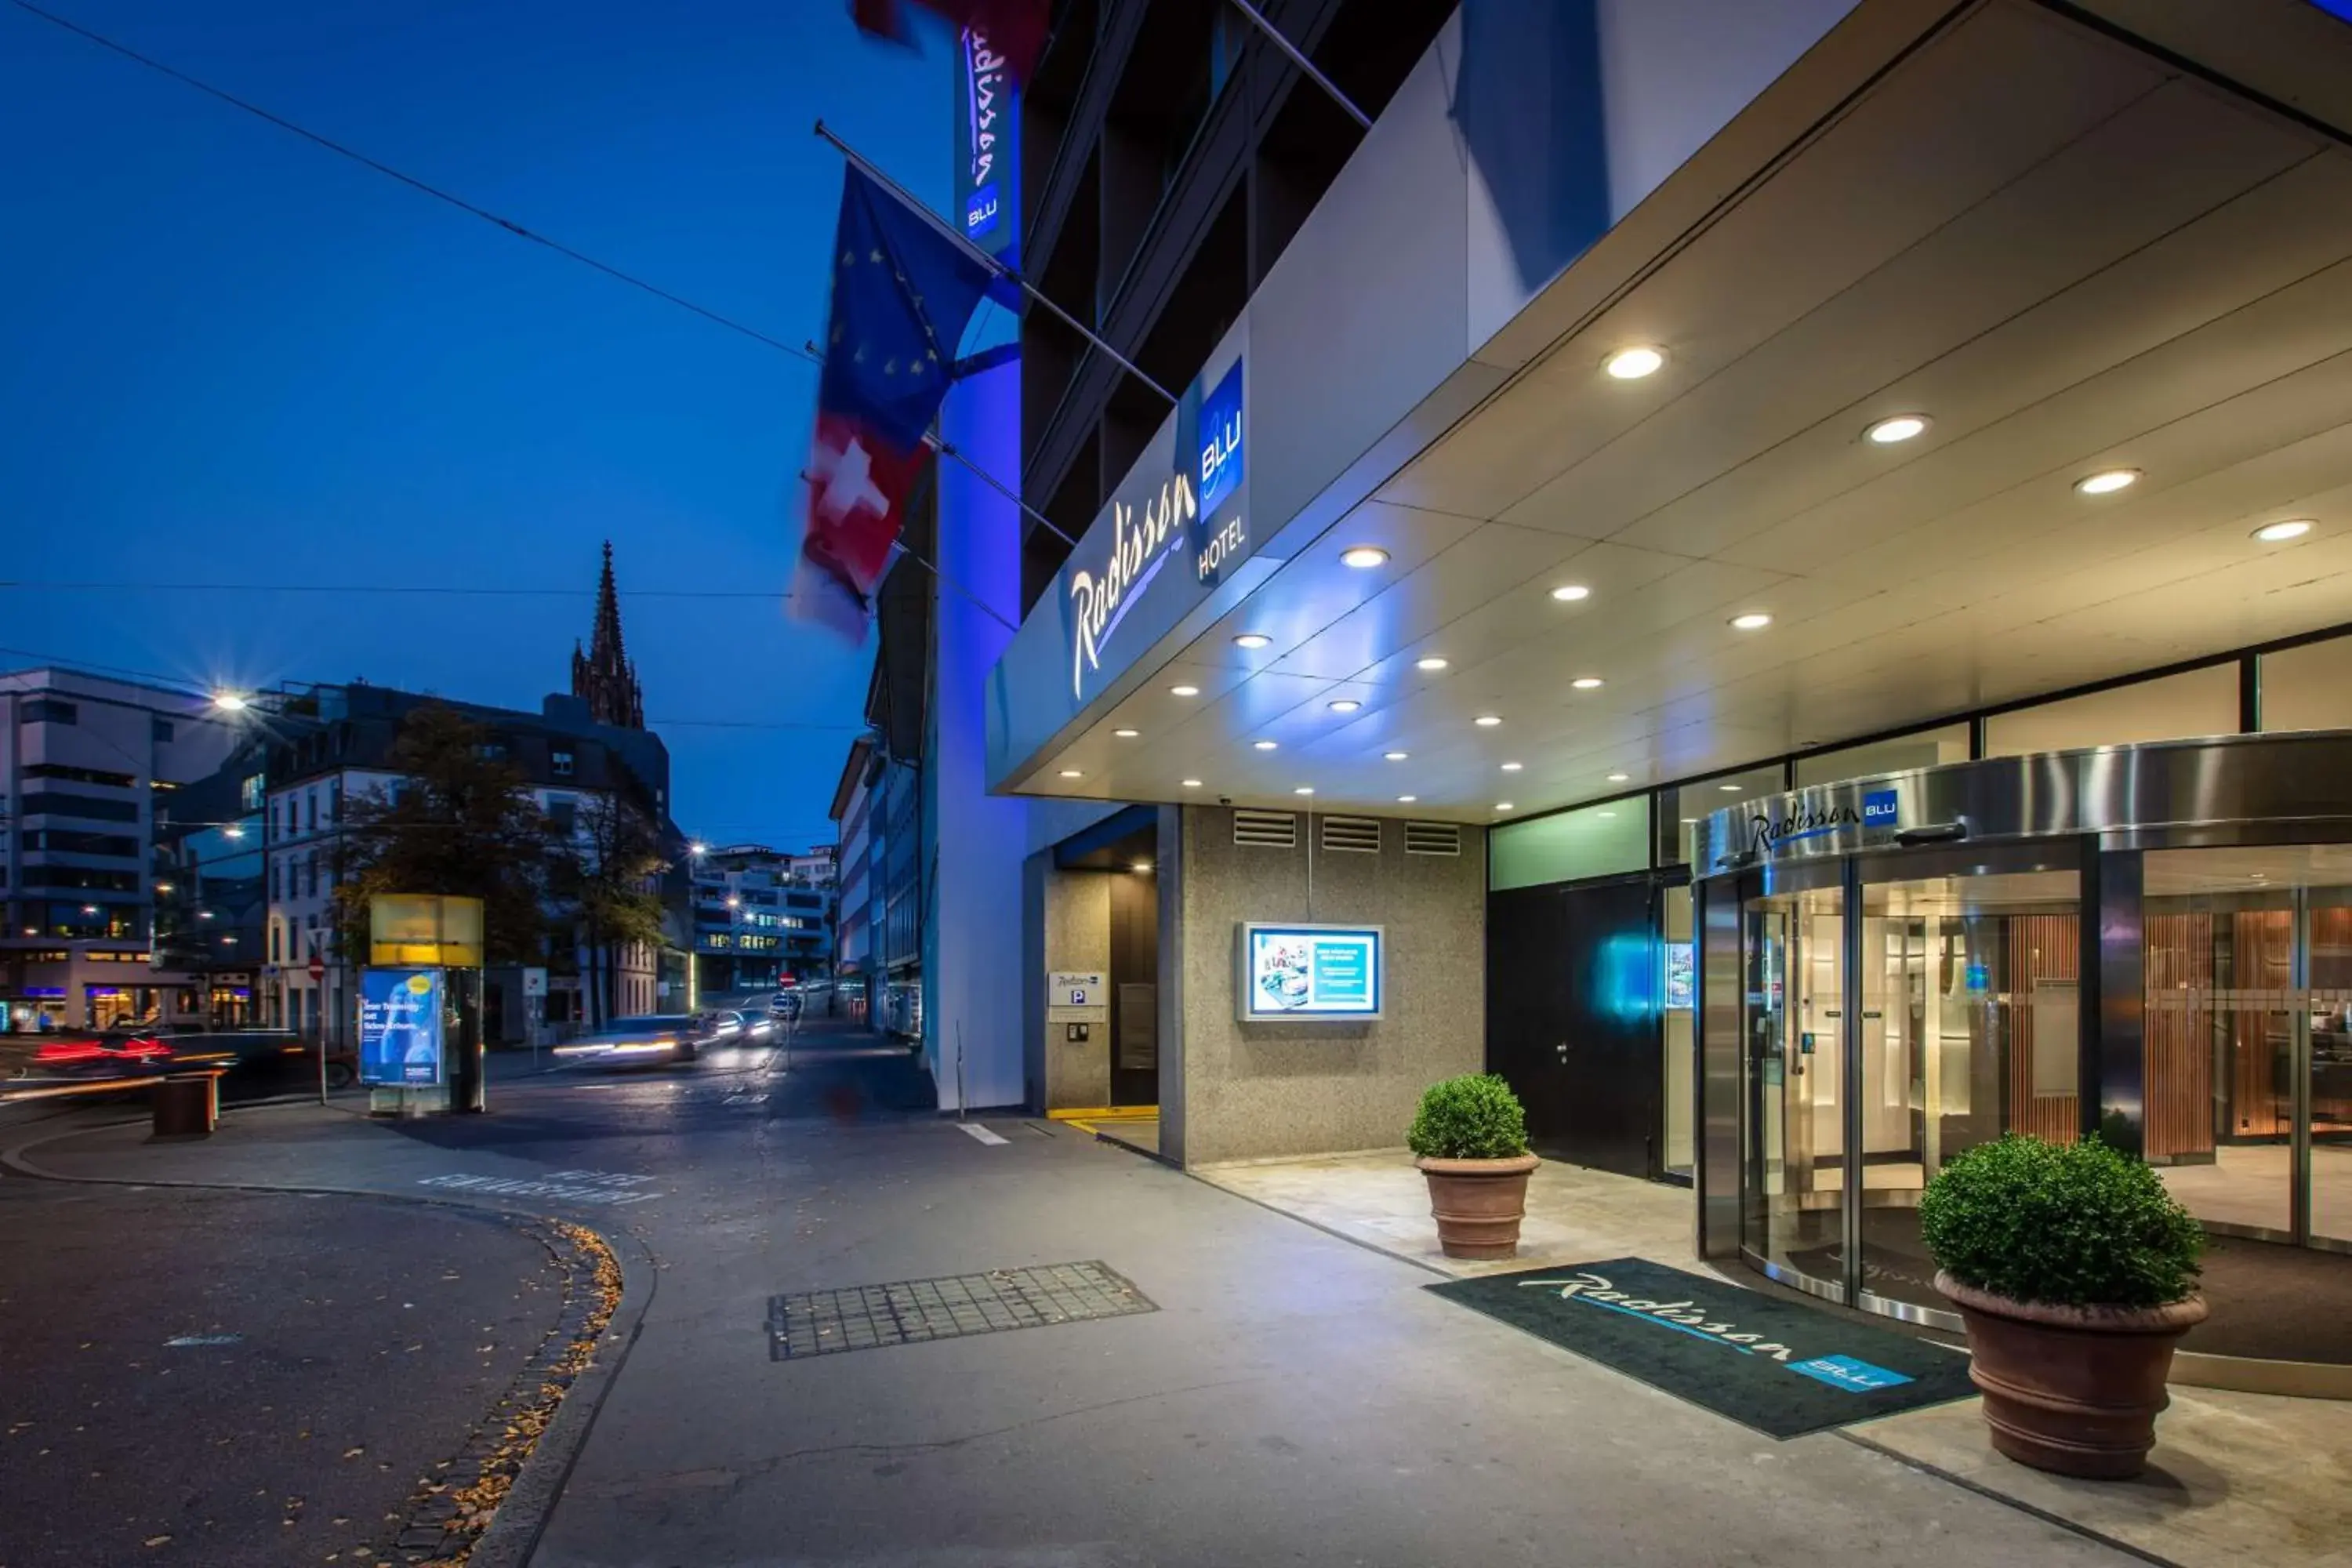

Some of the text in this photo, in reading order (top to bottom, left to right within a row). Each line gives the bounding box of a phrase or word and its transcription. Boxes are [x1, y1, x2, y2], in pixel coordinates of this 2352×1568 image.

[961, 26, 1006, 227] adisson BLU
[1071, 410, 1242, 701] Radisson BLU
[1199, 514, 1245, 580] HOTEL
[1750, 800, 1895, 861] Radisson BLU
[1074, 990, 1083, 1004] P
[1517, 1272, 1886, 1389] Radisson BLU
